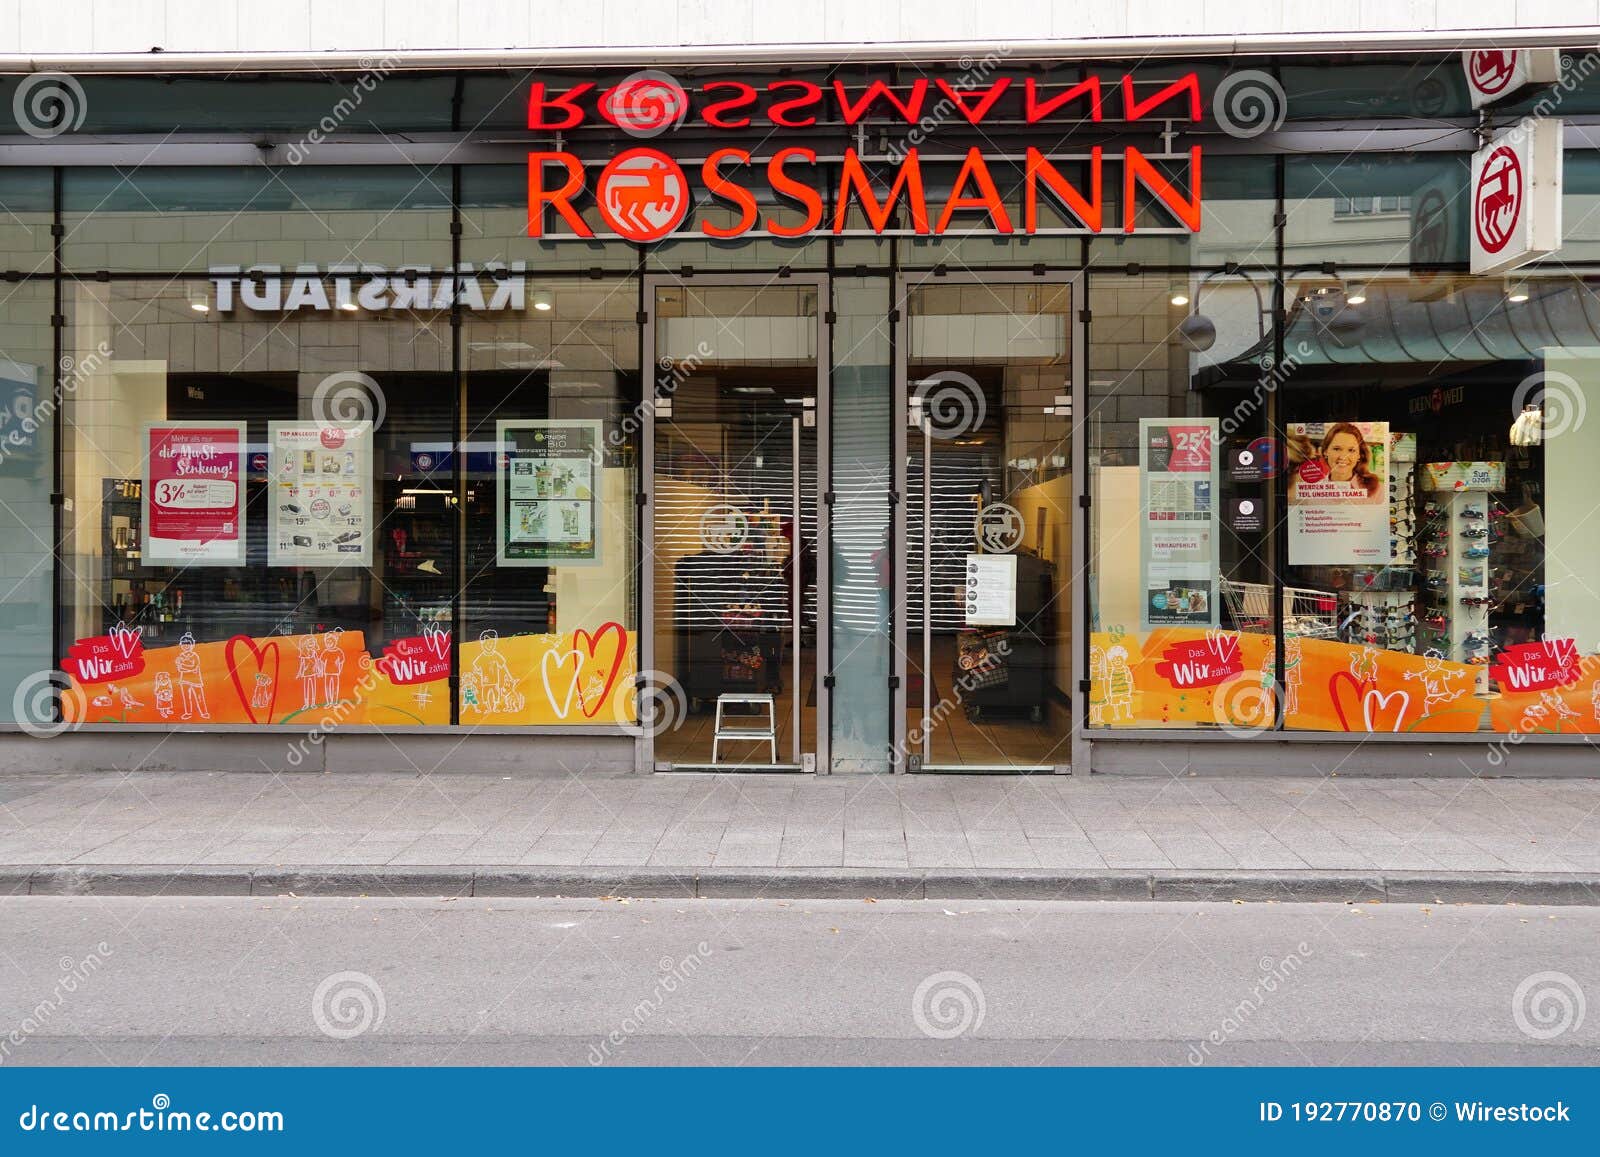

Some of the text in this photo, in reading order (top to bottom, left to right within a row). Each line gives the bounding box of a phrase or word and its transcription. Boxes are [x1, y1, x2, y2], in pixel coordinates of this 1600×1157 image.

[527, 145, 1201, 243] ROSSMANN
[159, 444, 177, 458] die
[548, 440, 567, 448] BIO
[176, 461, 233, 479] Senkung!
[1473, 470, 1488, 478] Sun
[160, 483, 185, 504] 3%
[92, 645, 109, 654] Das
[407, 646, 424, 654] Das
[1188, 649, 1205, 657] Das
[1523, 651, 1541, 661] Das
[78, 655, 134, 680] Wir zählt
[392, 656, 449, 681] Wir zählt
[1173, 660, 1232, 685] Wir zählt
[1507, 663, 1569, 688] Wir zählt
